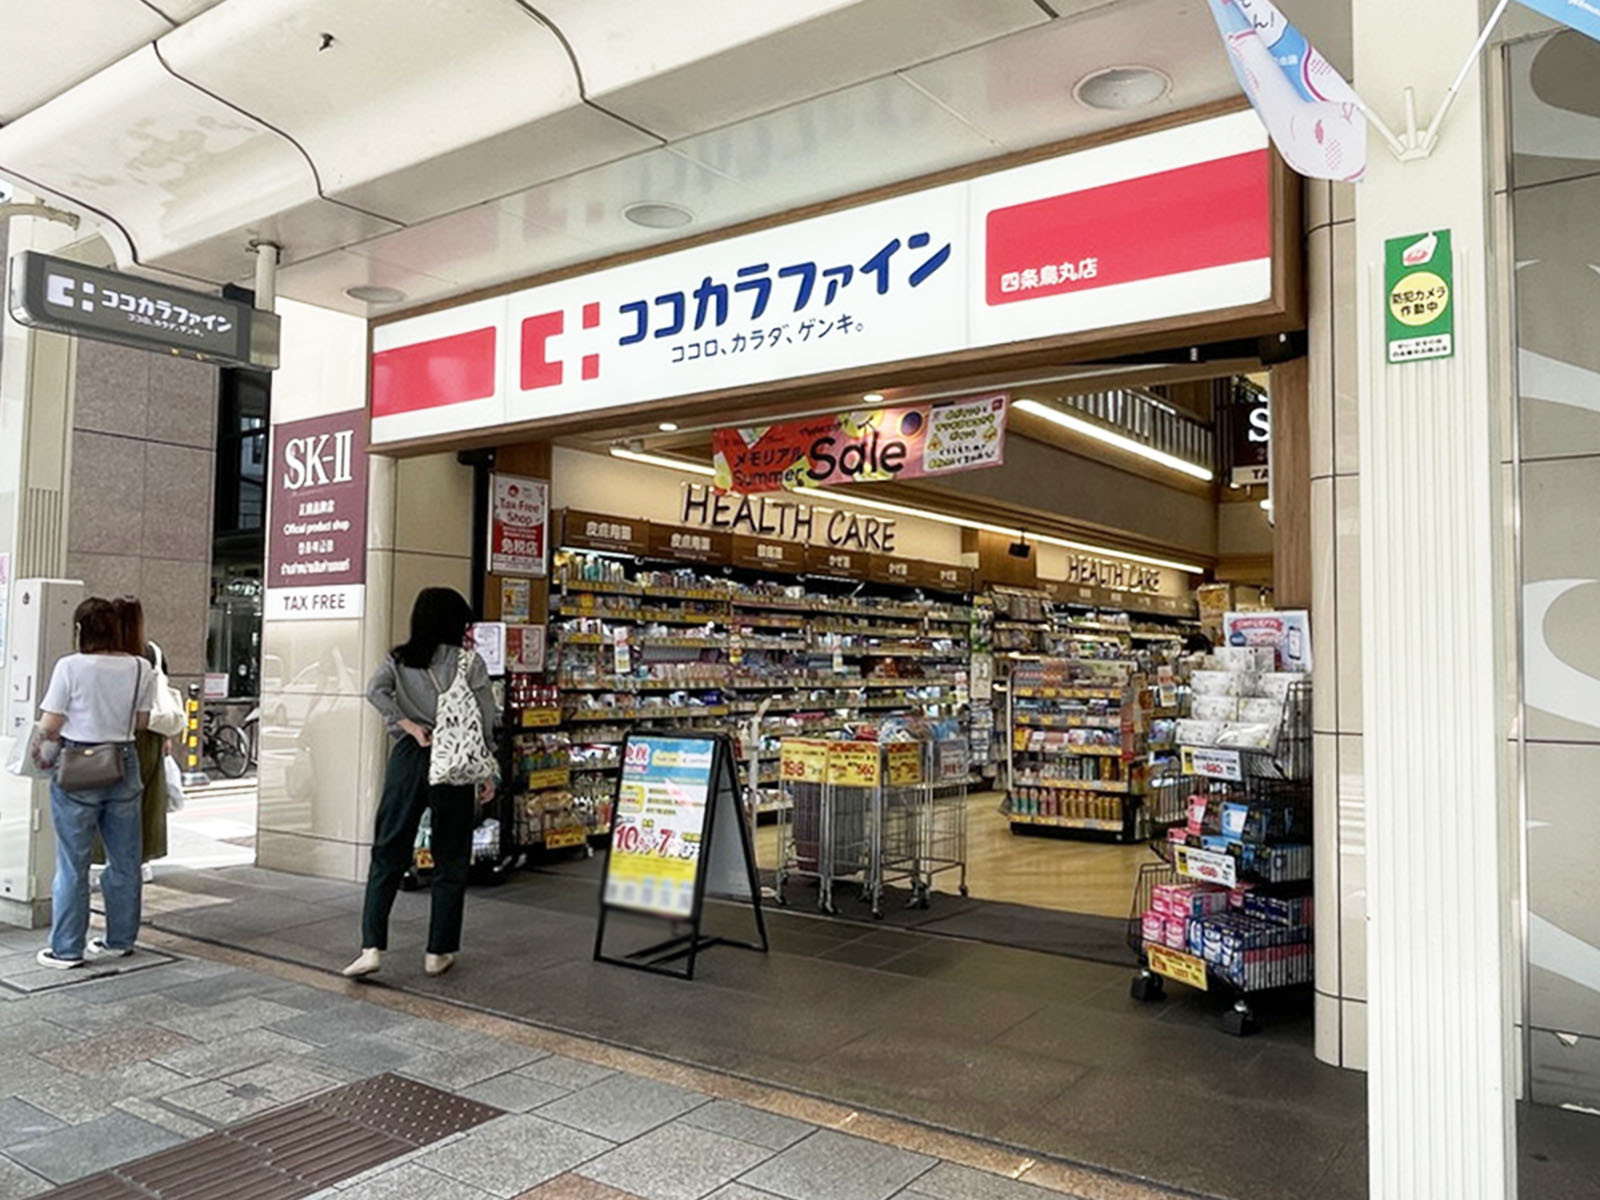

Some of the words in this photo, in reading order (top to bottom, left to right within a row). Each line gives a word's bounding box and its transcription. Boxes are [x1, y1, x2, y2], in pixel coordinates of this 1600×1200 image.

[101, 289, 232, 332] ココカラファイン
[618, 232, 952, 346] ココカラファイン
[1392, 286, 1446, 304] 防犯カメラ
[1400, 301, 1439, 317] 作動中
[671, 313, 865, 363] ココロ、カラダ、ゲンキ。
[806, 432, 906, 481] Sale
[683, 482, 814, 540] HEALTH
[826, 508, 896, 552] CARE
[1066, 554, 1124, 588] HEALTH
[283, 596, 308, 611] TAX
[312, 593, 346, 610] FREE
